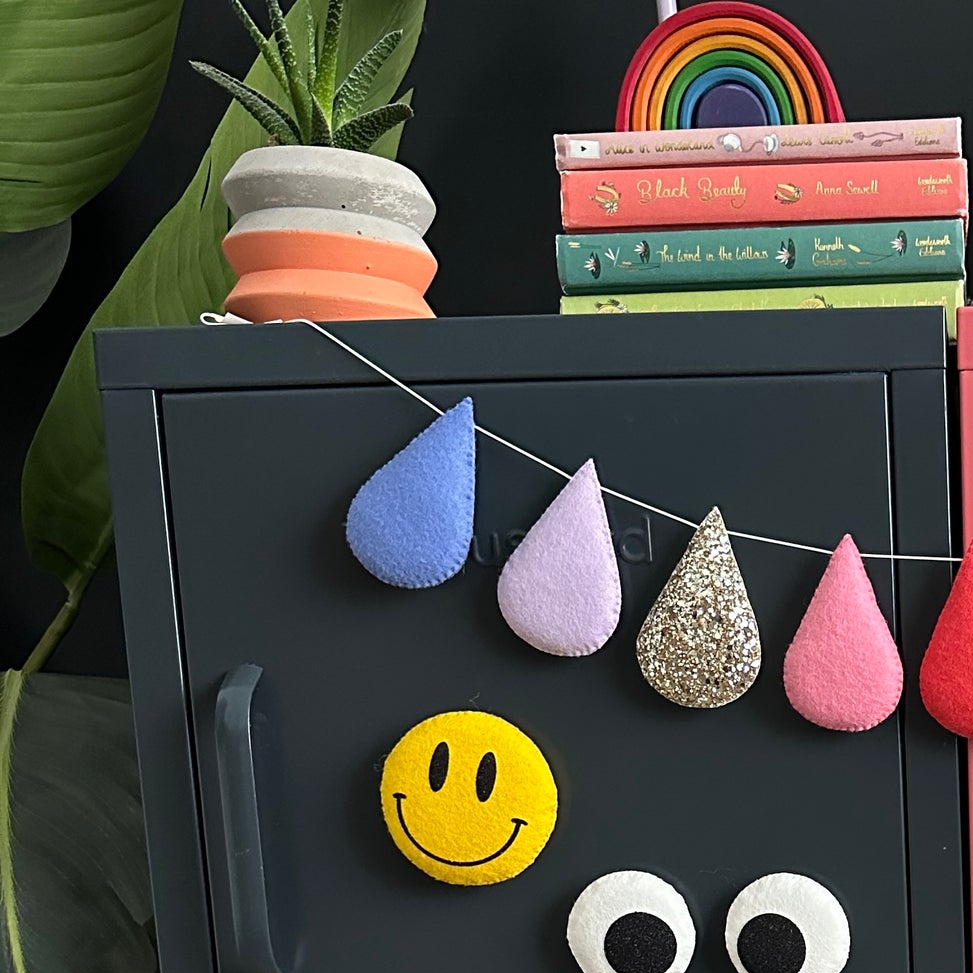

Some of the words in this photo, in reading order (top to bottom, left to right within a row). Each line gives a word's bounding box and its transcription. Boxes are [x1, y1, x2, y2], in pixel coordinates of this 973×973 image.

[636, 176, 690, 205] Black
[697, 175, 747, 210] Beauty
[815, 180, 842, 195] Anna
[845, 179, 880, 195] Sewell
[656, 244, 674, 263] The
[705, 252, 716, 262] in
[718, 245, 733, 261] the
